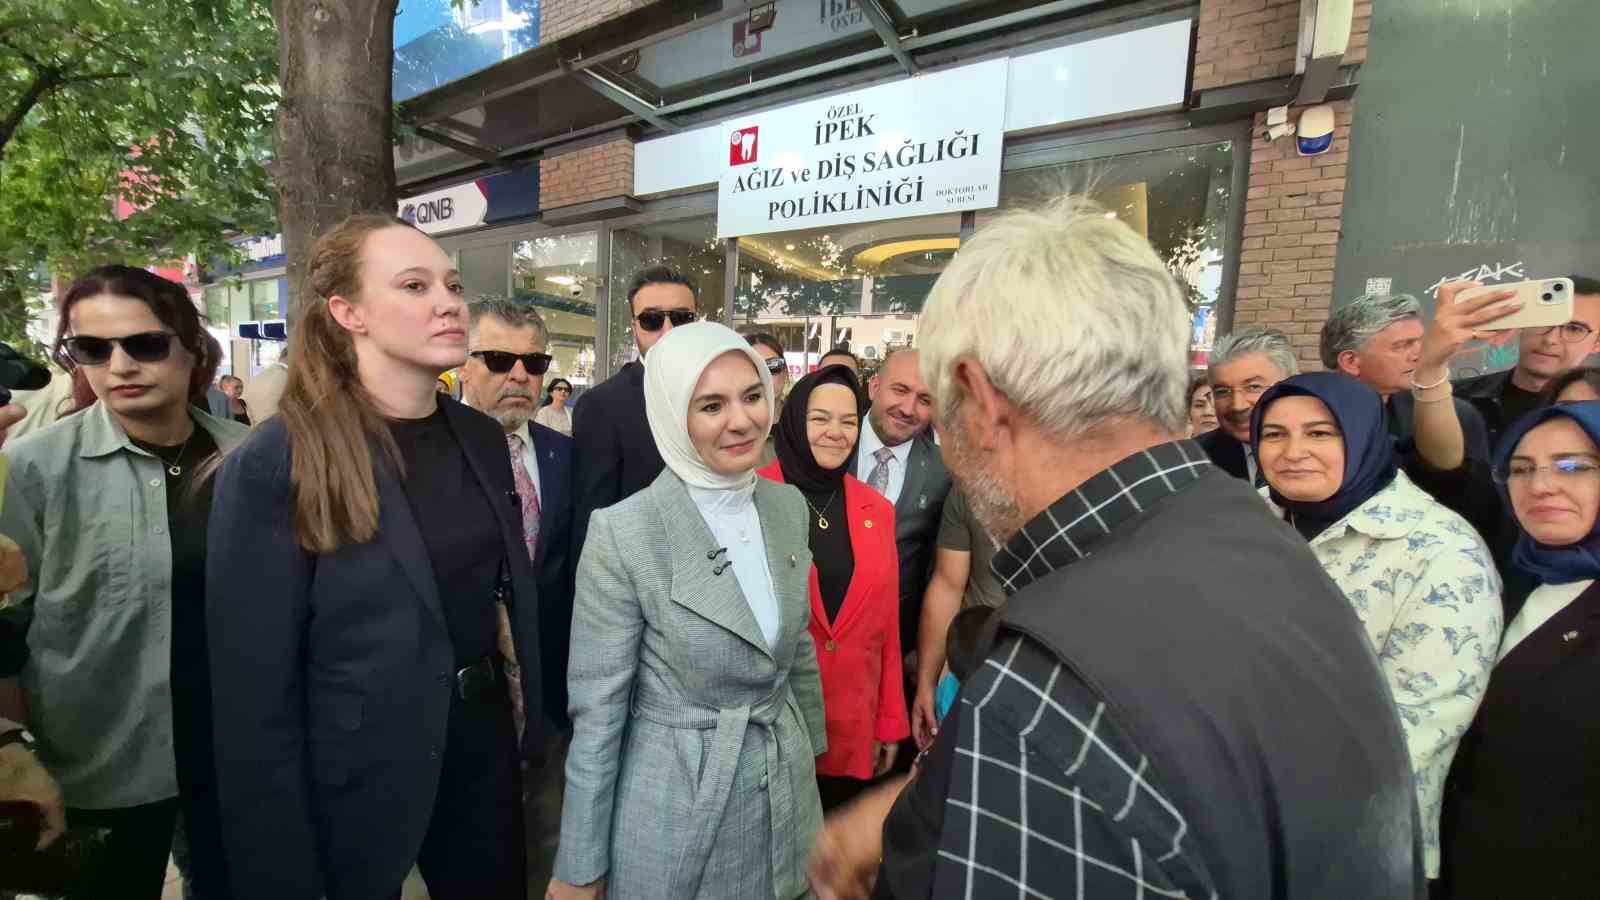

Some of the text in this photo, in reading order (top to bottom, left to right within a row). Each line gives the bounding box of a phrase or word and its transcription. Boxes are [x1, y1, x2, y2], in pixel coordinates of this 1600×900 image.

[827, 103, 863, 120] ÖZEL
[815, 114, 876, 146] İPEK
[731, 129, 980, 194] AĞIZ ve DİŞ SAĞLIĞI
[416, 197, 455, 225] QNB
[768, 175, 924, 221] POLİKLİNİĞİ
